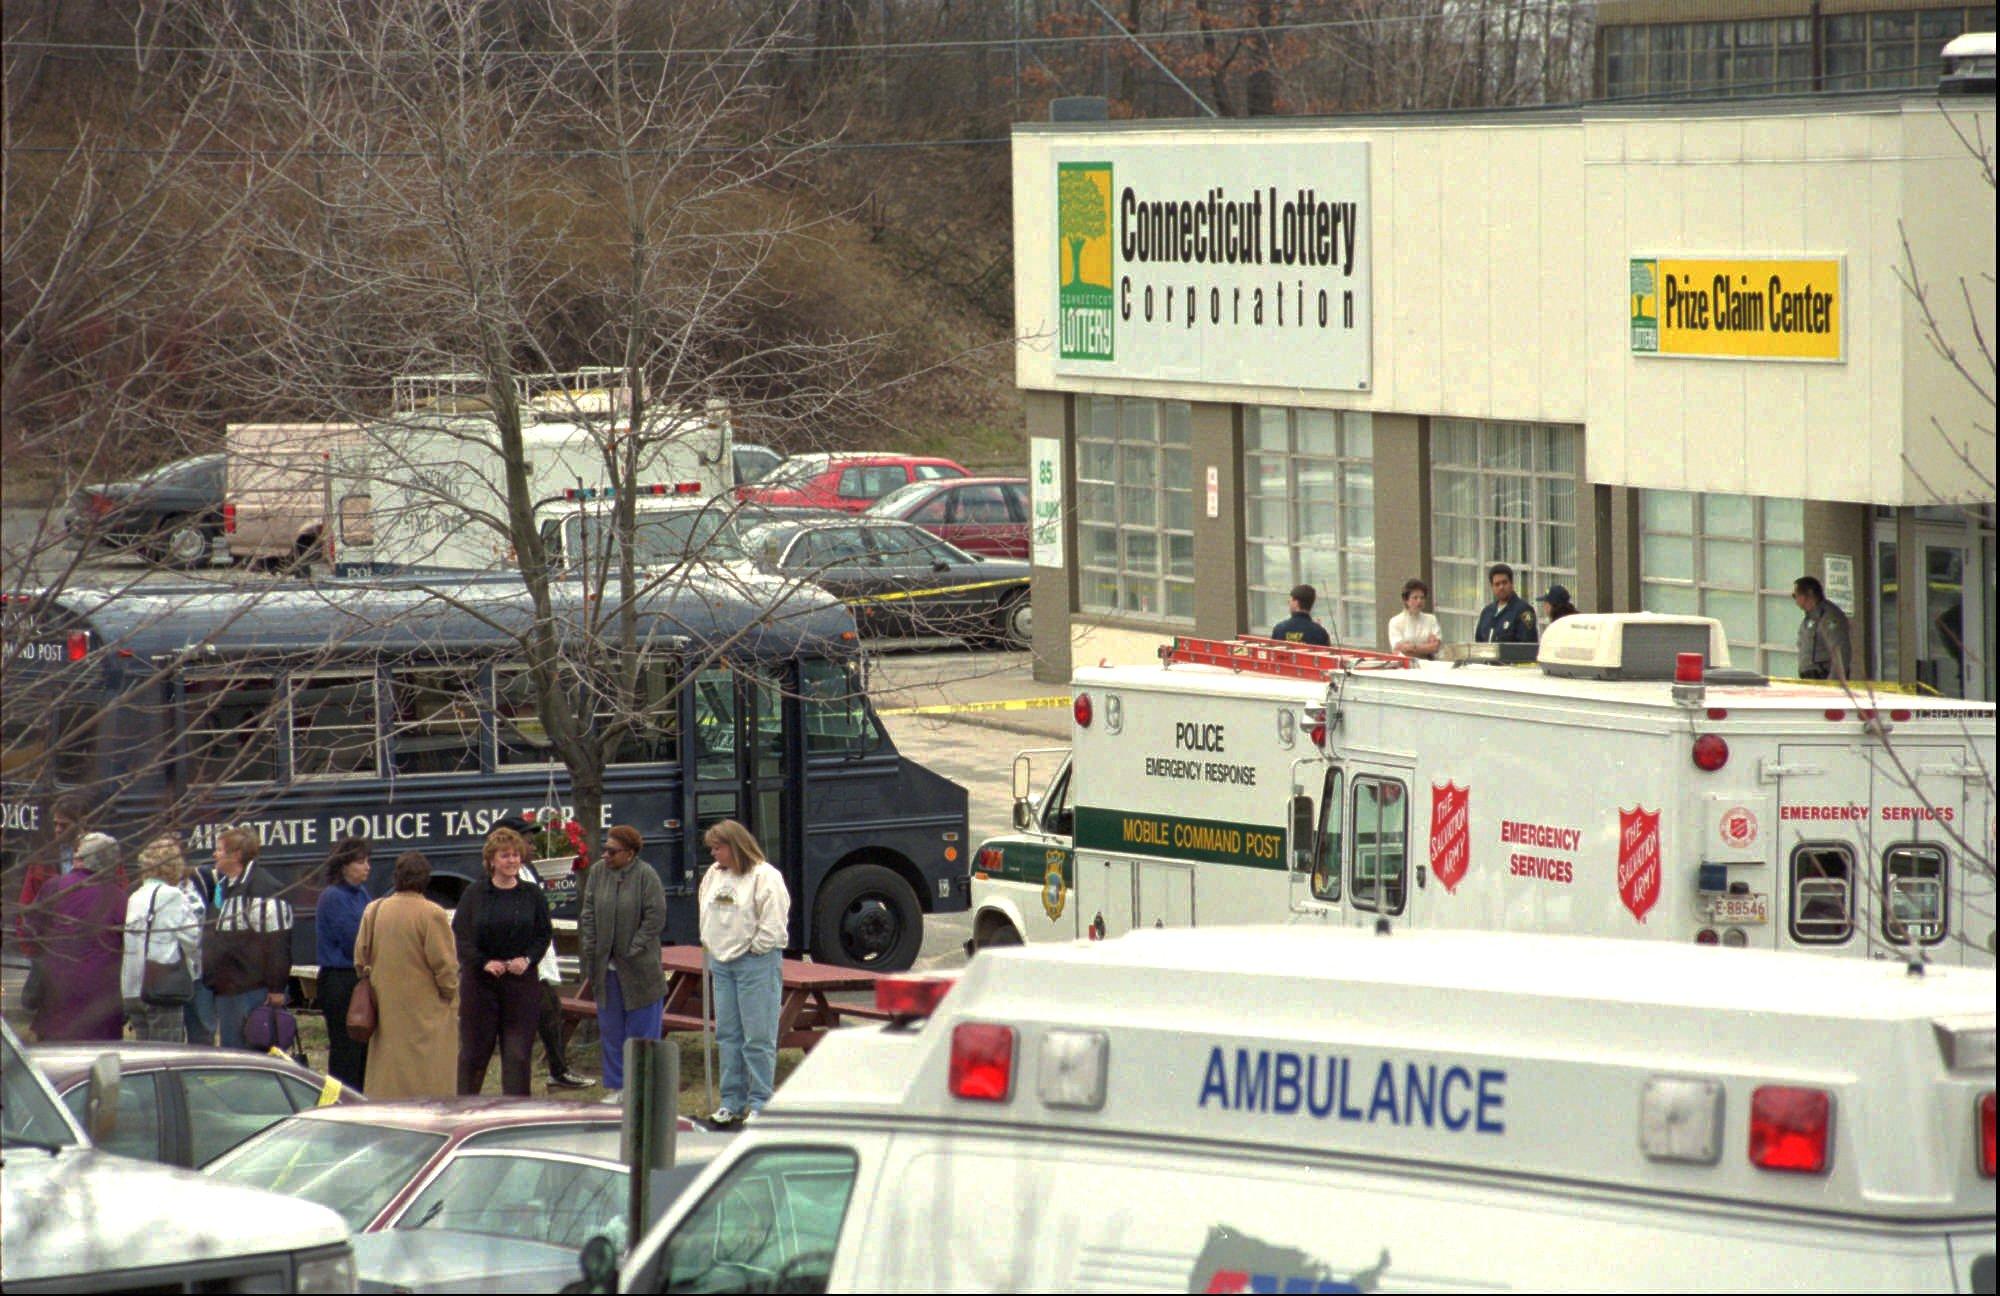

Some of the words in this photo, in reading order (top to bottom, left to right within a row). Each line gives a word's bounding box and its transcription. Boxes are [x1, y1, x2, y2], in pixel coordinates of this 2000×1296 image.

[1121, 186, 1263, 264] Connecticut
[1270, 186, 1357, 276] Lottery
[1121, 275, 1354, 329] Corporation
[1665, 273, 1709, 331] Prize
[1713, 273, 1764, 332] Claim
[1769, 275, 1833, 334] Center
[1061, 308, 1112, 354] LOTTERY
[1040, 460, 1053, 485] 85
[38, 644, 62, 661] POST
[1176, 722, 1225, 752] POLICE
[1145, 757, 1201, 780] EMERGENCY
[1205, 763, 1256, 786] RESPONSE
[330, 812, 431, 842] POLICE
[442, 807, 508, 836] TASK
[1780, 806, 1869, 821] EMERGENCY
[1881, 807, 1955, 821] SERVICES
[1123, 819, 1170, 846] MOBILE
[1174, 824, 1241, 854] COMMAND
[1246, 832, 1281, 858] POST
[1501, 820, 1581, 851] EMERGENCY
[1625, 816, 1642, 851] THE
[1443, 831, 1466, 880] ARMY
[1510, 854, 1574, 884] SERVICES
[1632, 857, 1657, 907] ARMY
[1197, 1045, 1508, 1135] AMBULANCE
